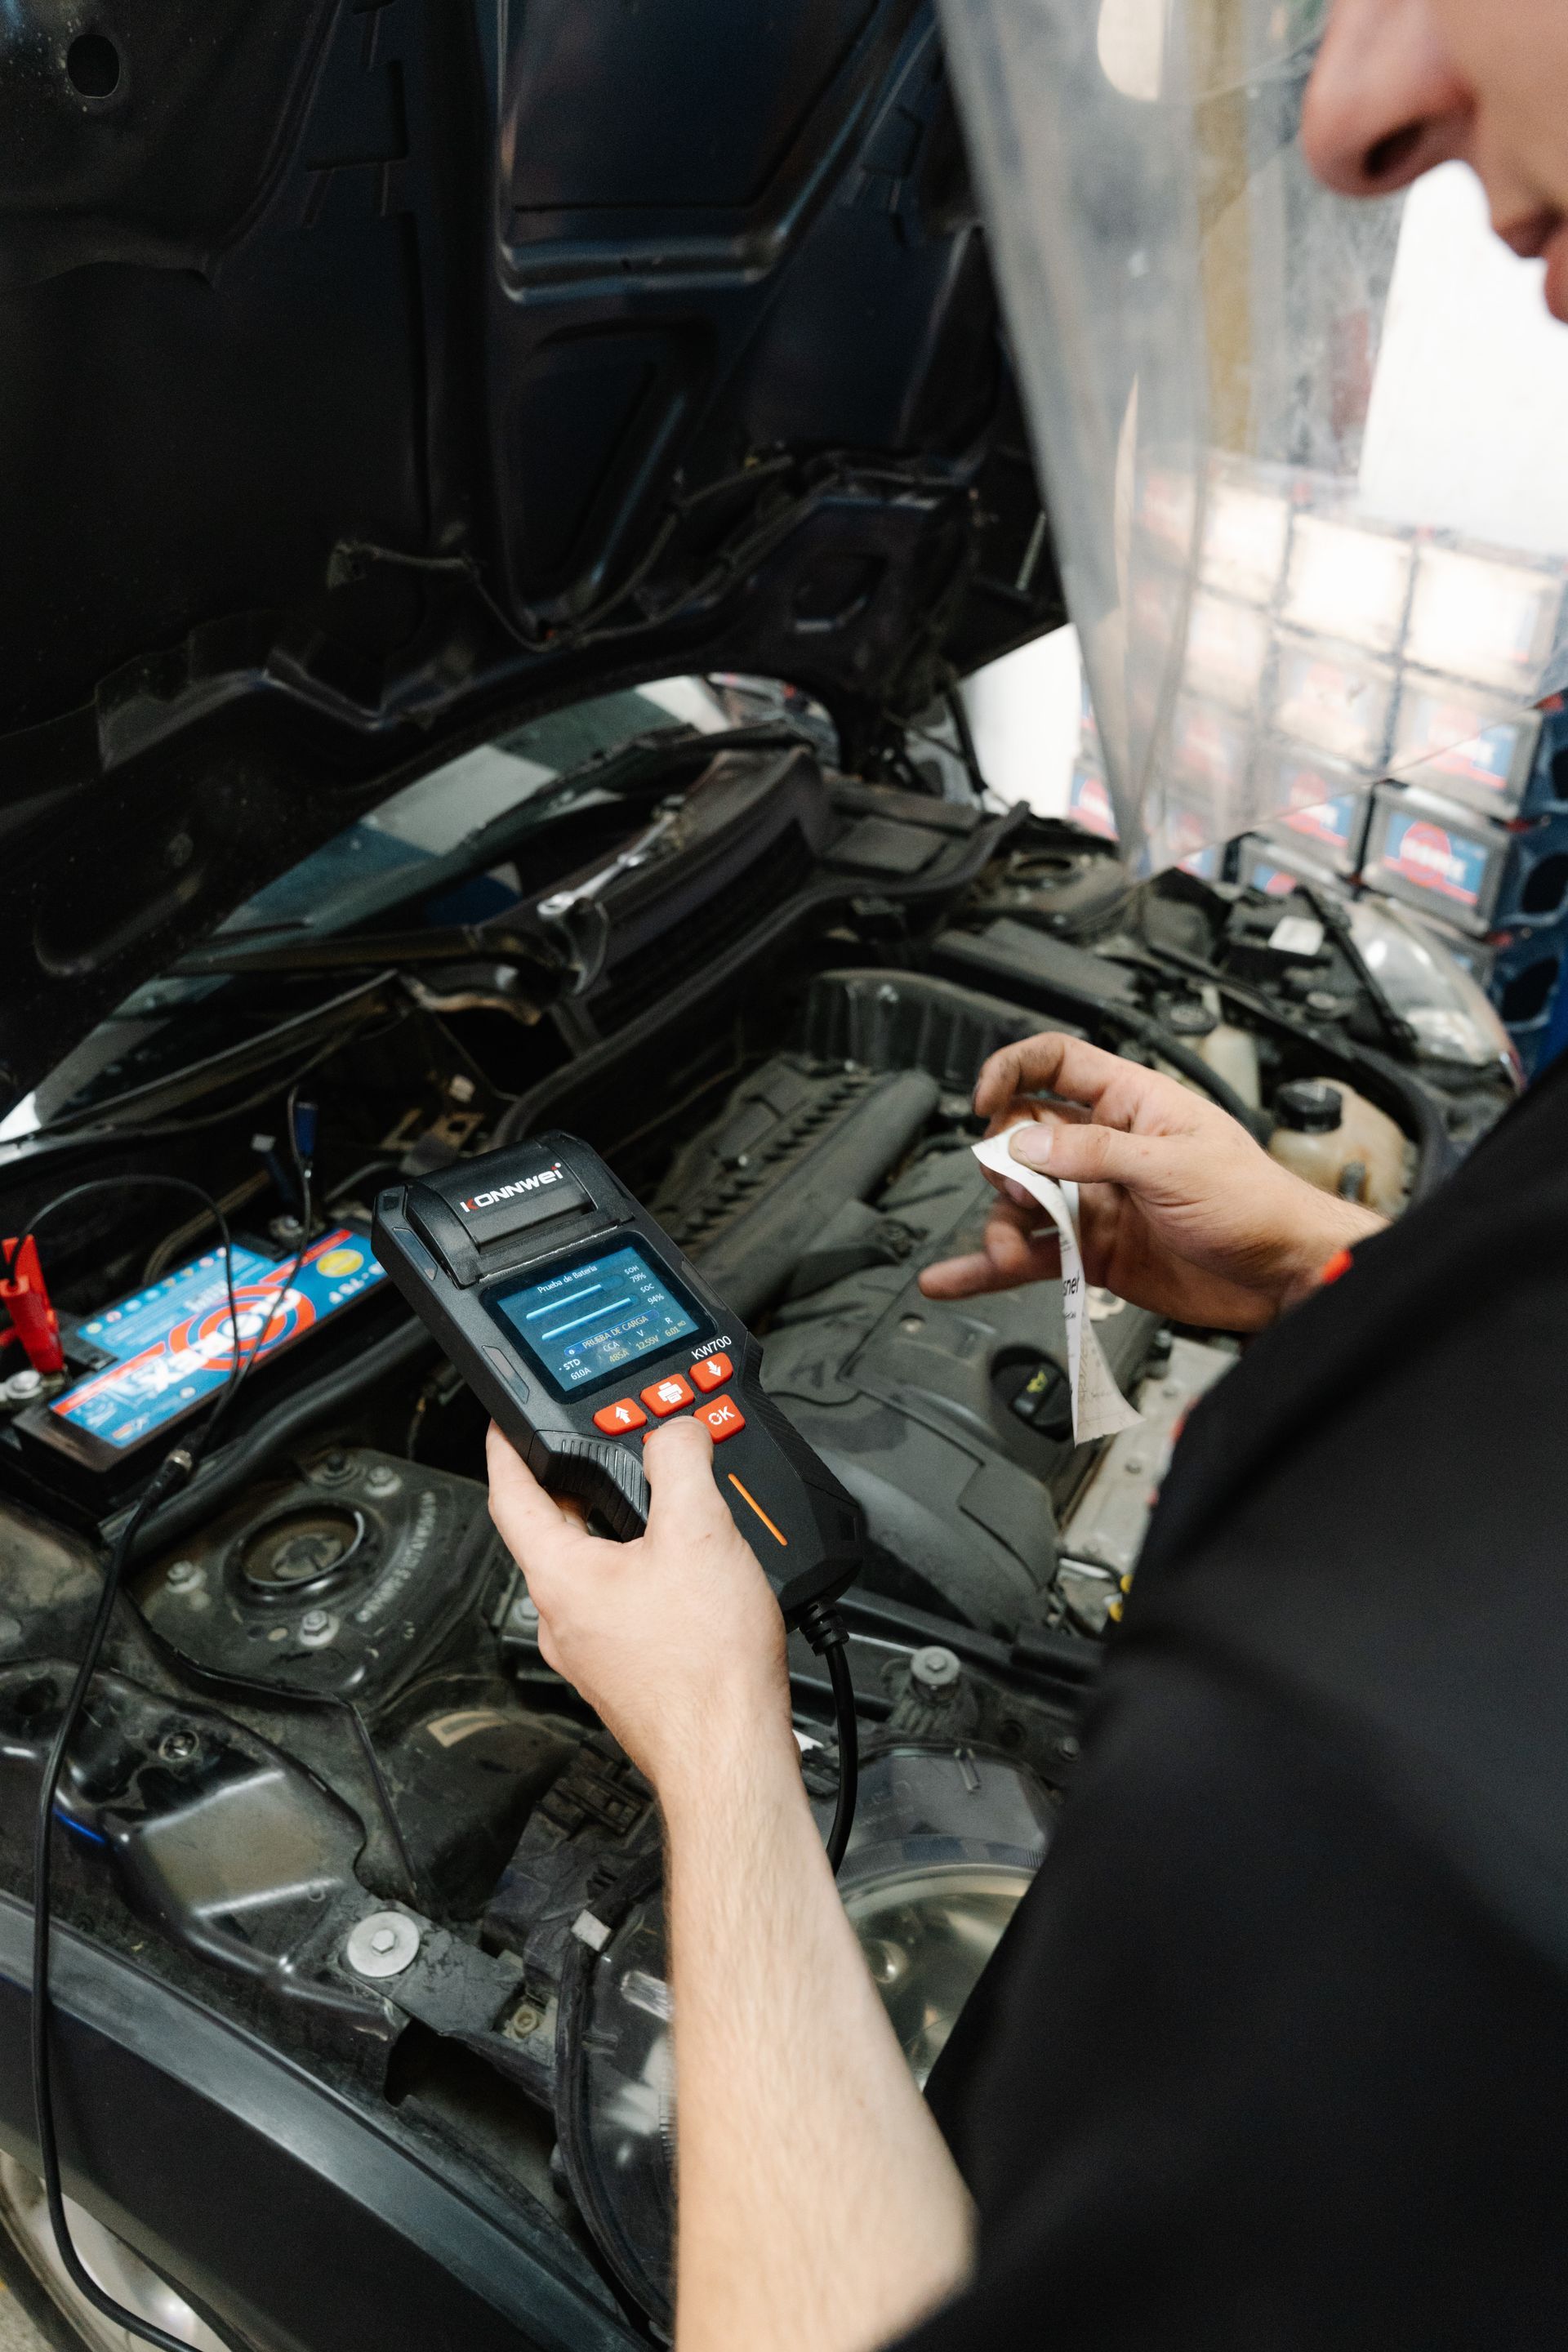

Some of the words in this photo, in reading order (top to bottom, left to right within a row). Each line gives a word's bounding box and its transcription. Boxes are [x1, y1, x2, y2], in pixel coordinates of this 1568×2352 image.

[624, 1265, 639, 1276] SOH
[630, 1272, 647, 1283] 79%
[537, 1280, 563, 1294] Prueba
[563, 1275, 572, 1284] de
[639, 1284, 655, 1294] SOC
[647, 1294, 665, 1306] 94%
[582, 1332, 612, 1349] PRUEBA
[611, 1327, 621, 1337] DE
[621, 1316, 649, 1332] CARGA
[563, 1358, 581, 1371] STD
[603, 1341, 621, 1352] CCA
[691, 1335, 732, 1360] KW700
[570, 1367, 592, 1380] 610A
[609, 1349, 630, 1363] 485A
[708, 1405, 736, 1425] OK
